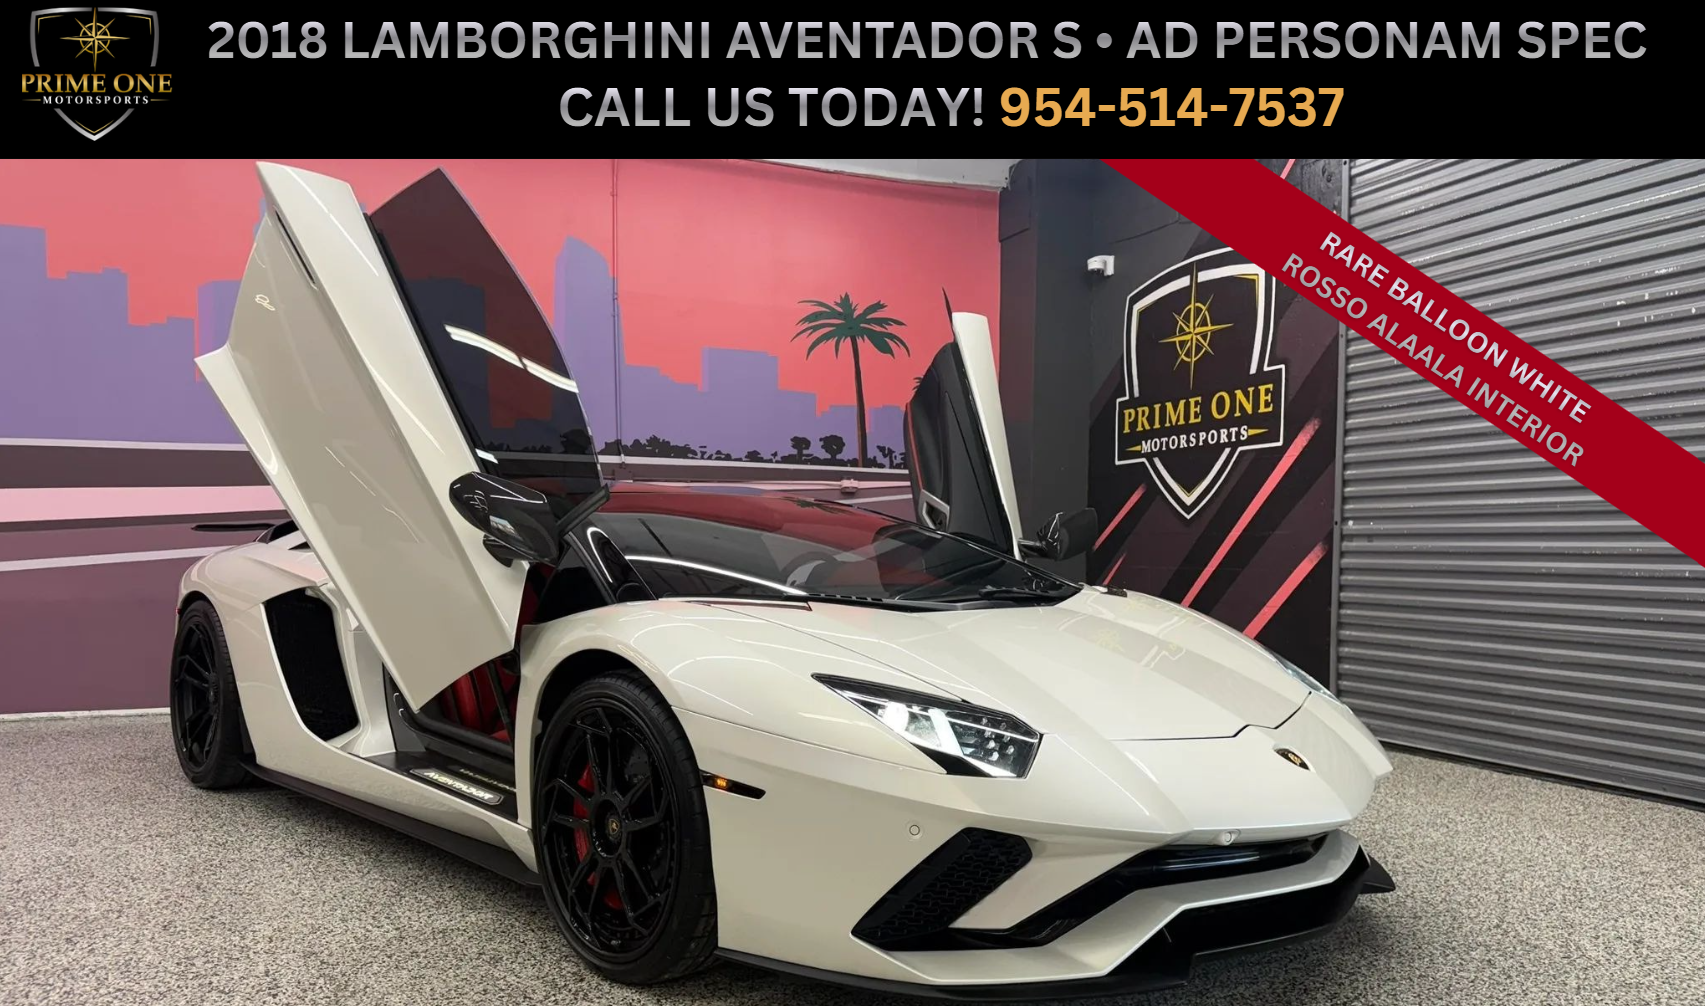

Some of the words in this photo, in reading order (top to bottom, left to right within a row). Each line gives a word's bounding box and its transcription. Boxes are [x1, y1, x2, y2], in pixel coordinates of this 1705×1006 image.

[1122, 396, 1202, 434] PRIME
[1210, 383, 1274, 420] ONE
[1141, 425, 1248, 454] MOTORSPORTS
